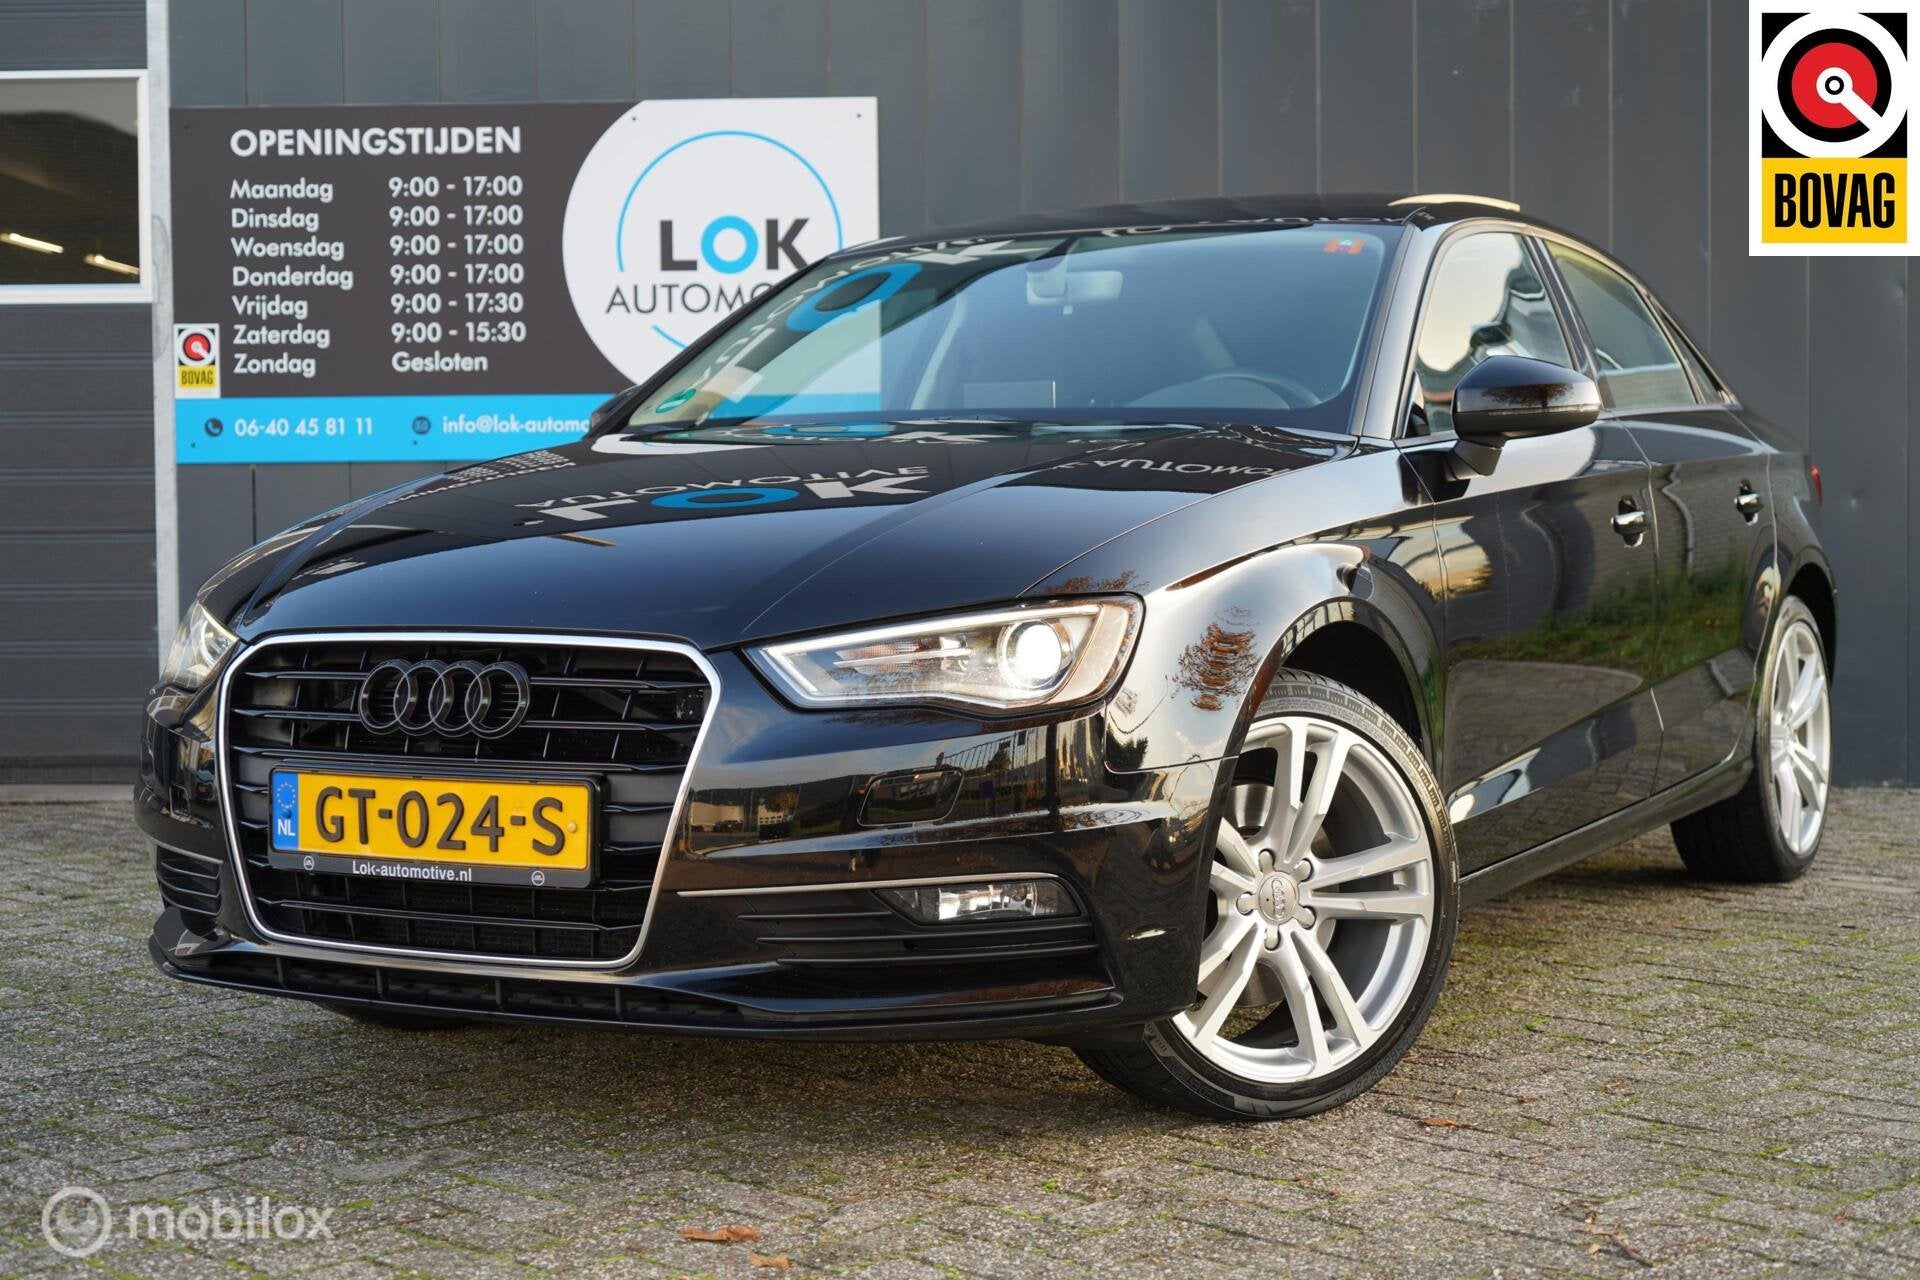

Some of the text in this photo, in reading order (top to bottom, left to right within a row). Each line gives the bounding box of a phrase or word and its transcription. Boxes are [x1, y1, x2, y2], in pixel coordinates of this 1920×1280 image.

[229, 126, 522, 157] OPENINGSTIJDEN
[229, 176, 334, 203] Maandag
[388, 176, 440, 198] 9:00
[462, 174, 524, 197] 17:00
[231, 206, 320, 233] Dinsdag
[388, 205, 441, 227] 9:00
[463, 204, 524, 226] 17:00
[230, 235, 345, 262] Woensdag
[389, 234, 441, 257] 9:00
[463, 233, 524, 255] 17:00
[659, 214, 811, 275] LOK
[232, 263, 354, 291] Donderdag
[389, 263, 442, 286] 9:00
[464, 262, 525, 285] 17:00
[231, 294, 309, 321] Vrijdag
[390, 292, 442, 315] 9:00
[464, 291, 524, 314] 17:30
[232, 322, 331, 349] Zaterdag
[390, 321, 443, 344] 9:00
[465, 320, 527, 343] 15:30
[181, 370, 214, 385] BOVAG
[233, 349, 489, 378] Zondag Gesloten
[234, 416, 374, 437] 06-40 45 81 11
[277, 818, 296, 837] NL
[315, 786, 566, 856] GT-024-S
[352, 859, 473, 882] Lok-automotive.nl
